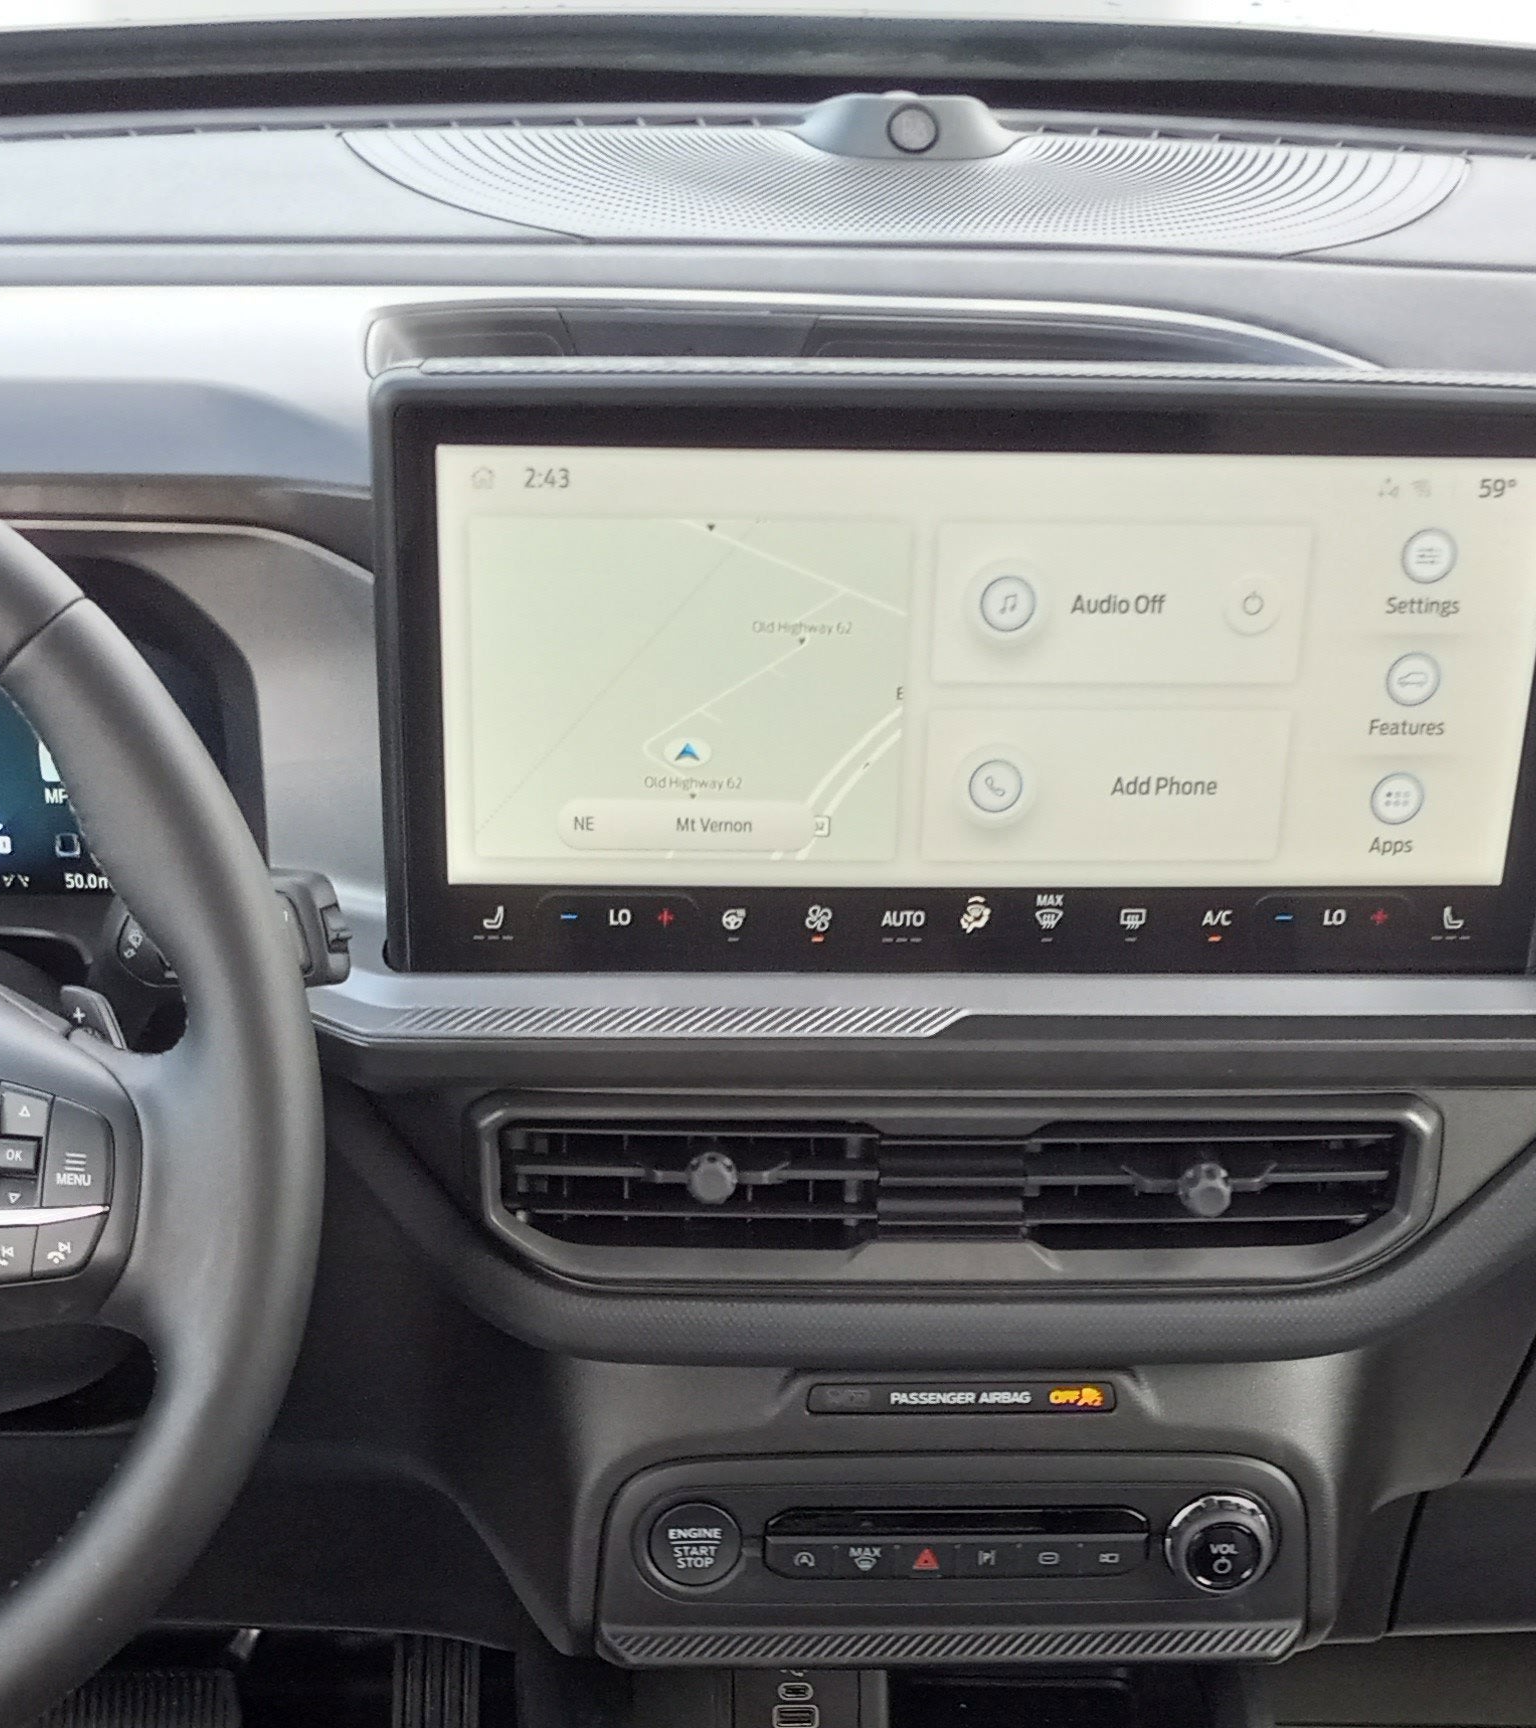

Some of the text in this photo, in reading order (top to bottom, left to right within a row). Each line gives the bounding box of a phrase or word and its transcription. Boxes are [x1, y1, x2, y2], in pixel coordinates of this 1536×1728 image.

[523, 468, 570, 489] 2:43
[1479, 478, 1519, 499] 59°
[1071, 594, 1166, 615] Audio Off
[1385, 596, 1460, 618] Settings
[752, 621, 852, 636] Old Highway 62
[1368, 719, 1446, 736] Features
[644, 776, 743, 791] Old Highway 62
[1111, 777, 1218, 796] Add Phone
[573, 816, 595, 831] NE
[676, 818, 753, 832] Mt Vernon
[1368, 838, 1413, 857] Apps
[1036, 895, 1063, 907] MAX
[609, 910, 632, 927] LO
[882, 910, 926, 928] AUTO
[1202, 909, 1232, 928] A/C
[1323, 909, 1346, 927] LO
[5, 1149, 23, 1161] OK
[56, 1173, 91, 1187] MENU
[890, 1391, 1032, 1405] PASSENGER AIRBAG
[668, 1528, 723, 1540] ENGINE
[673, 1546, 718, 1558] START
[848, 1547, 882, 1558] MAX
[1210, 1543, 1239, 1555] VOL
[677, 1557, 714, 1569] STOP
